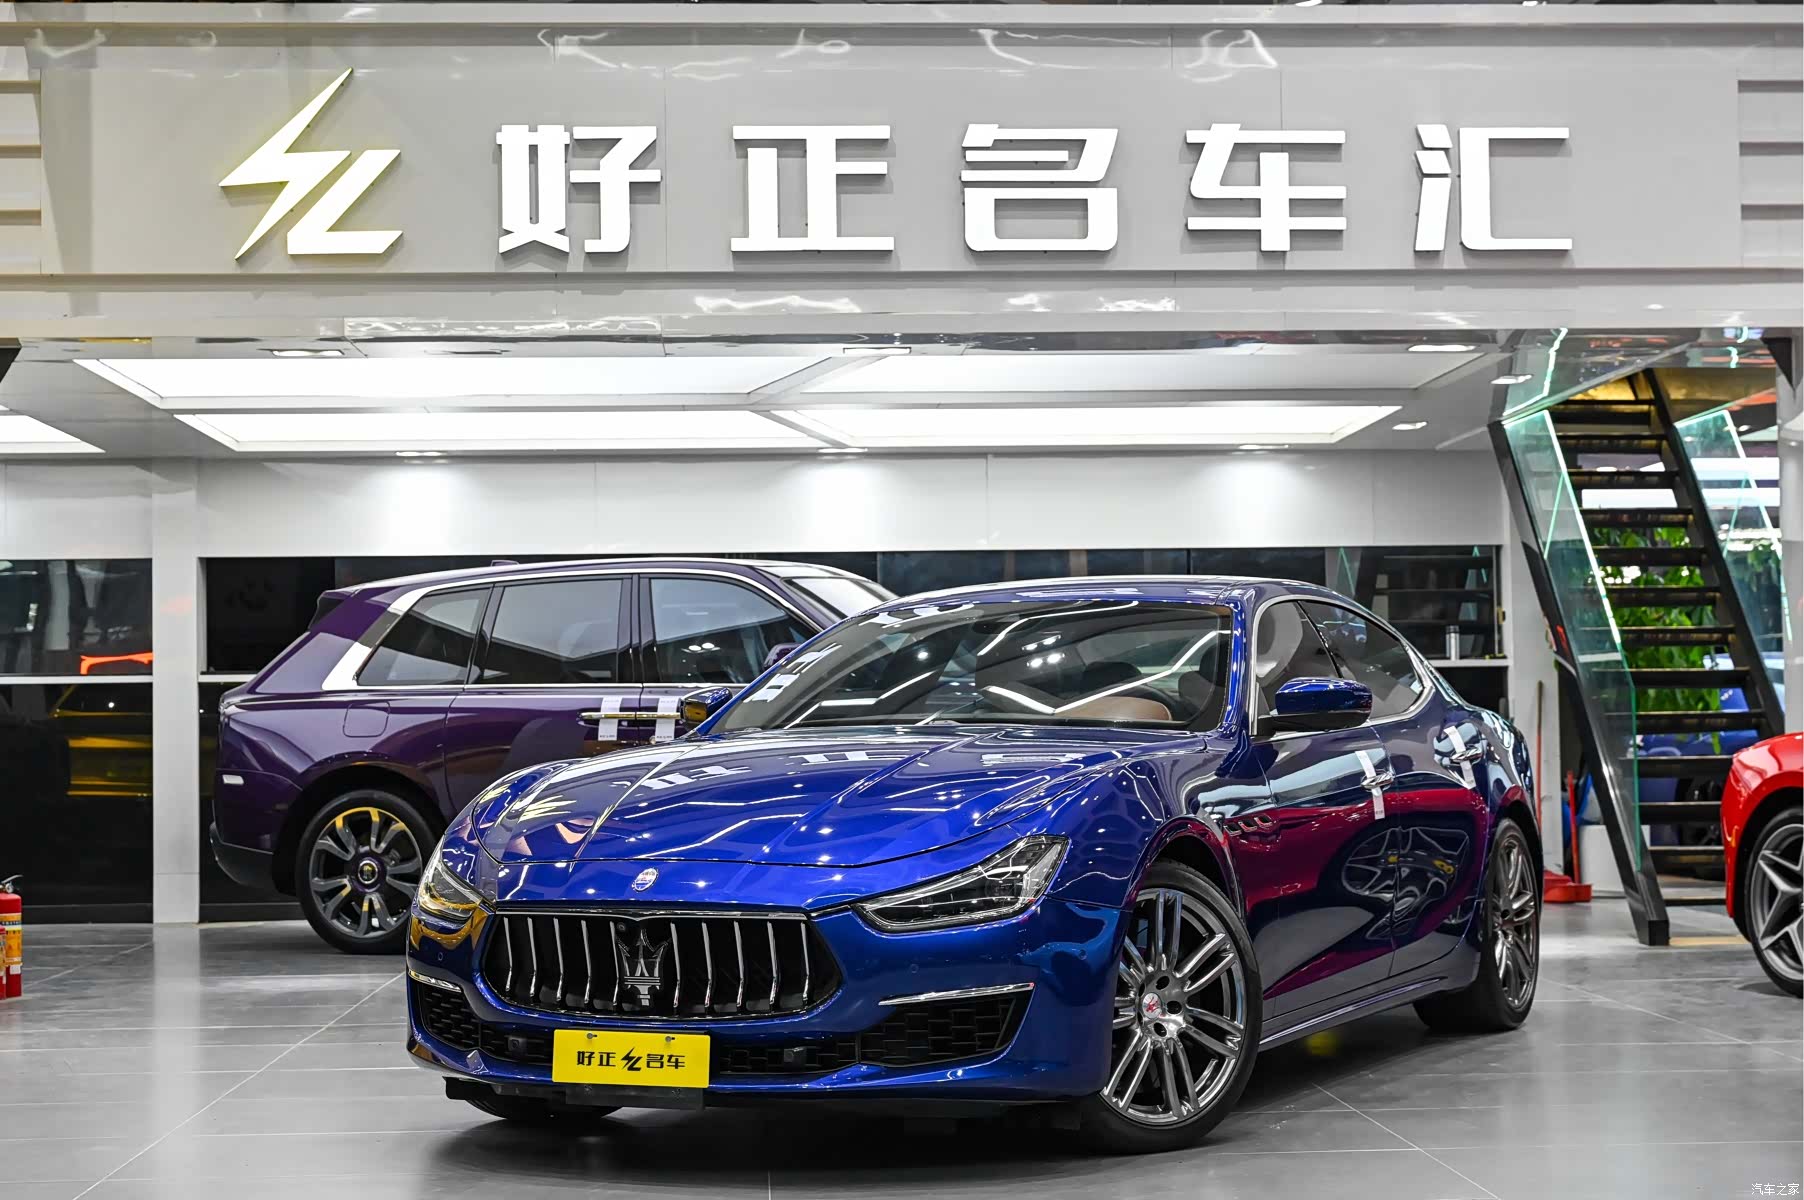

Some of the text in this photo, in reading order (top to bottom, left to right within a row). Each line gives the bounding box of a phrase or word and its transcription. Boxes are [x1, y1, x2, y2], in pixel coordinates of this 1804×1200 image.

[496, 123, 1572, 253] 好正名车汇
[576, 1050, 686, 1070] 好正 名车
